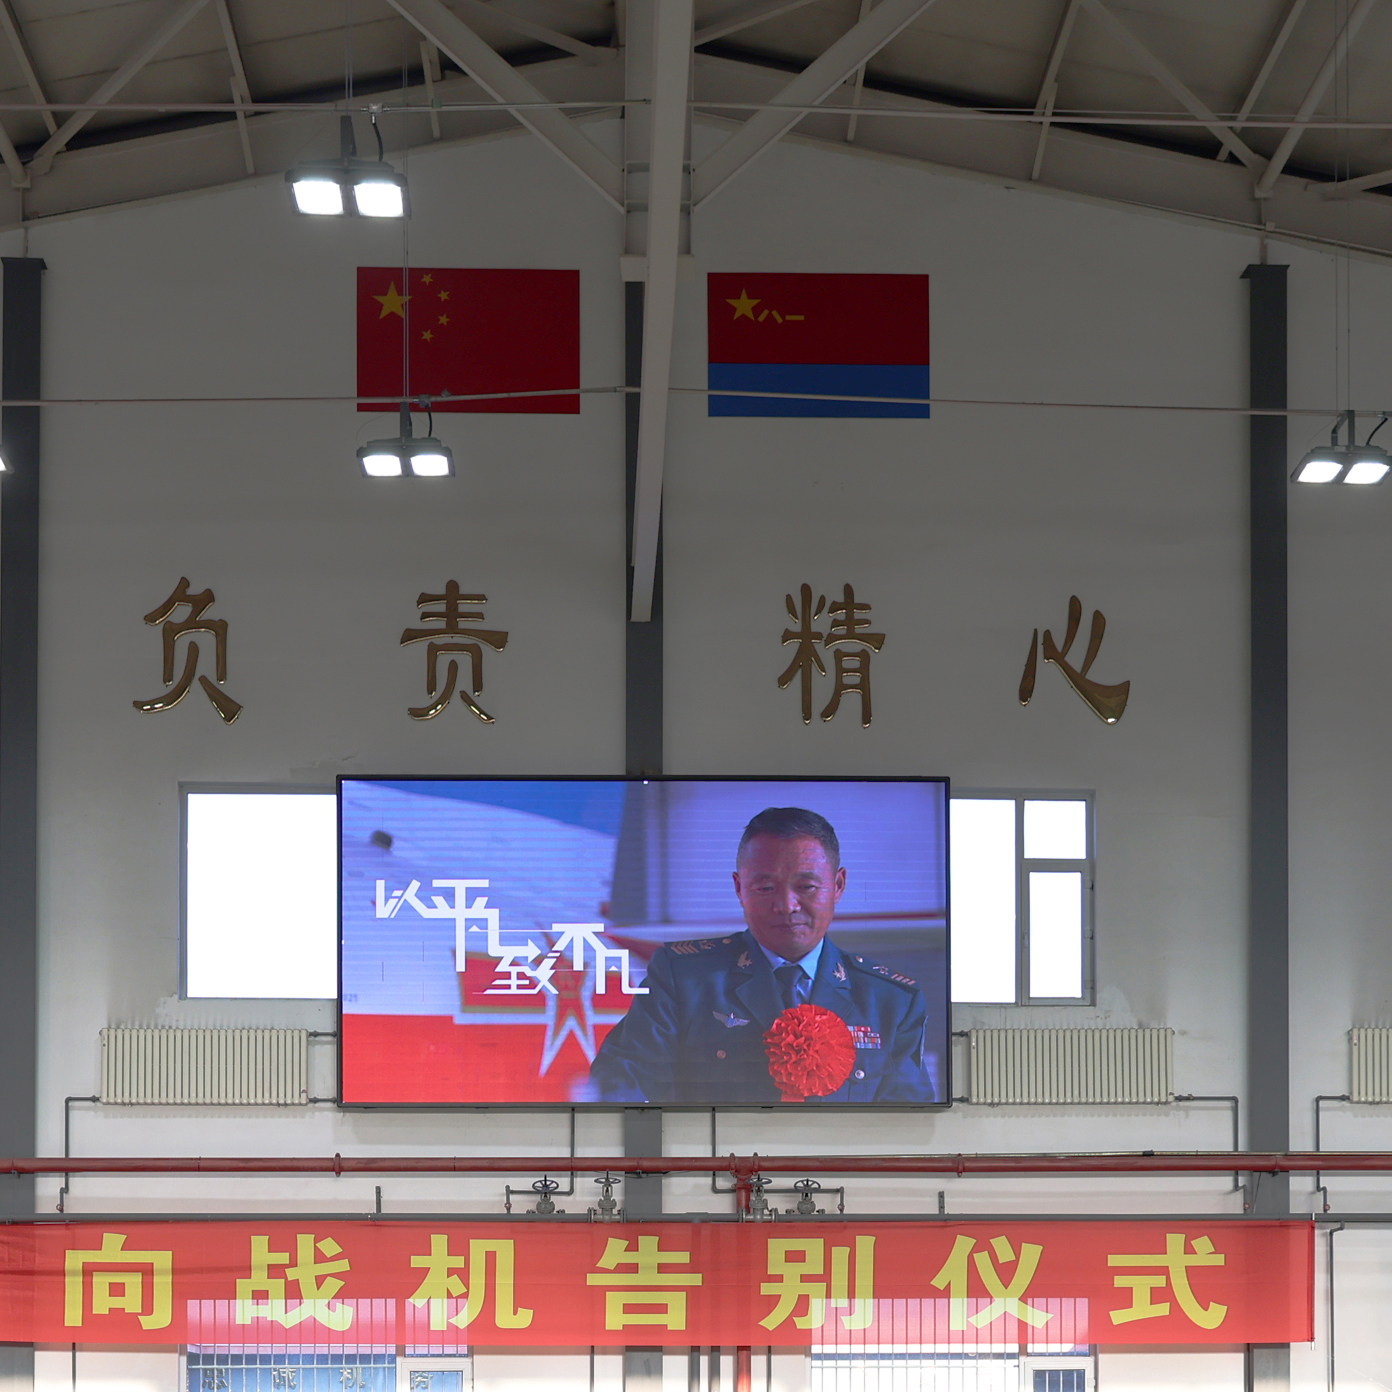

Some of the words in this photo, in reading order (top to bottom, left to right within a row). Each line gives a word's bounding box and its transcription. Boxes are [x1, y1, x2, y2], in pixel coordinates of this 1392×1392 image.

[62, 1233, 1228, 1331] 向战机告别仪式
